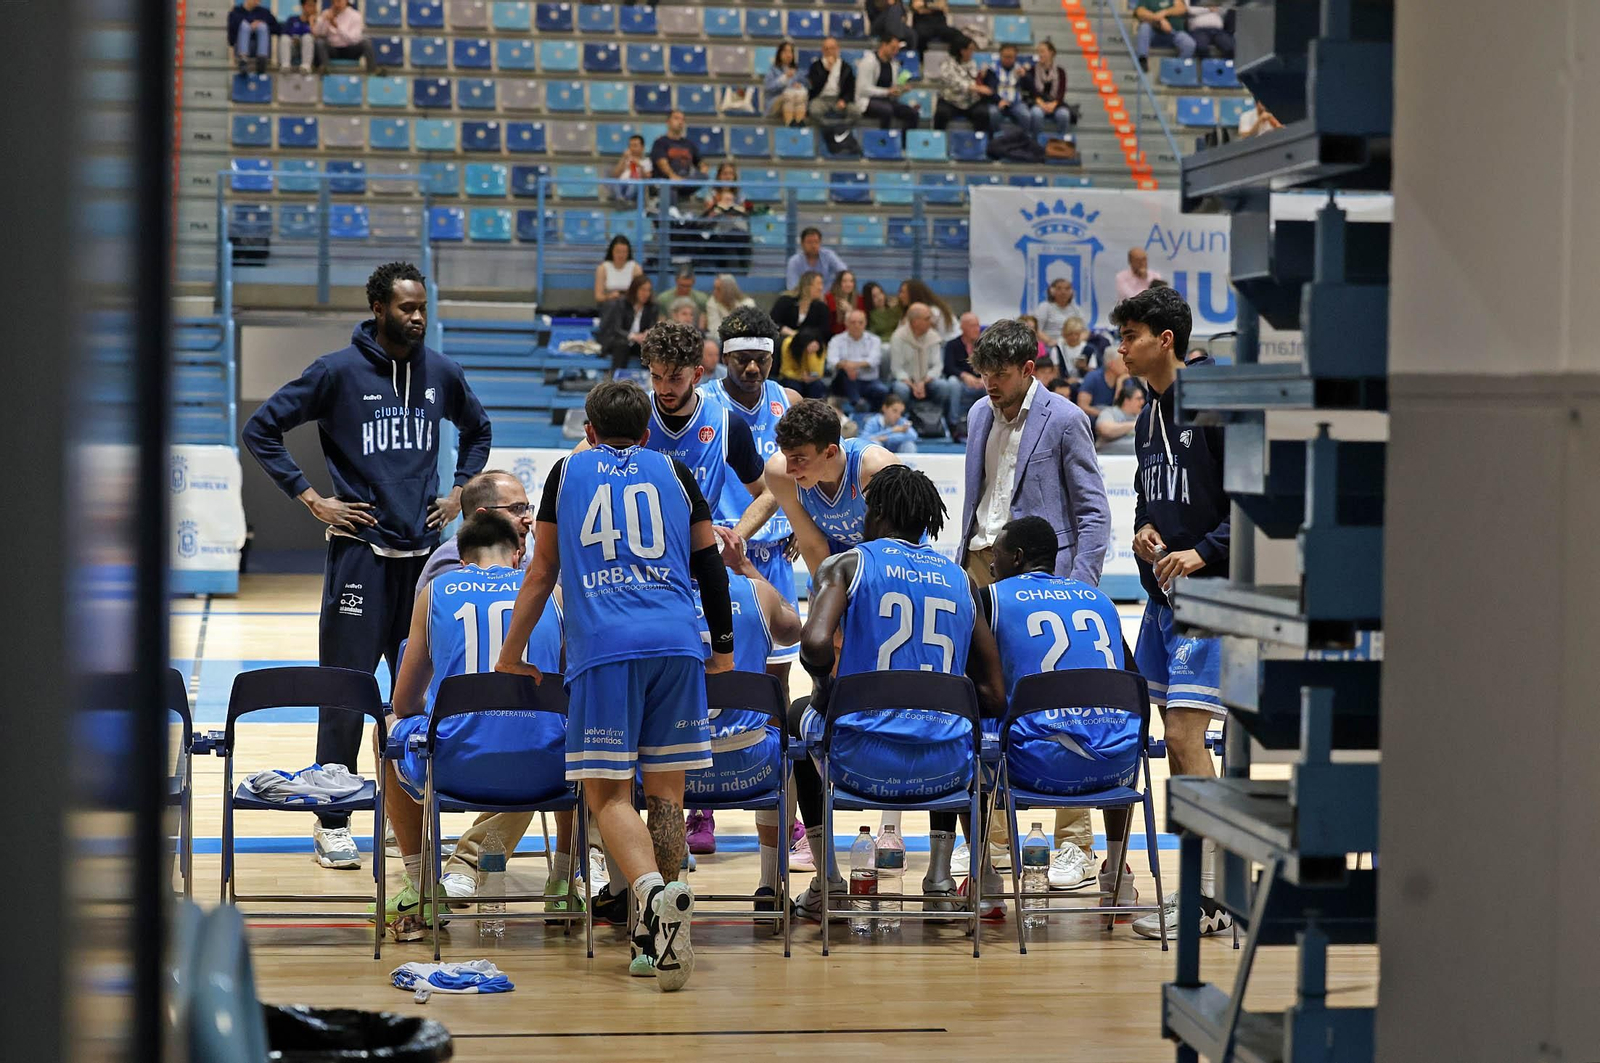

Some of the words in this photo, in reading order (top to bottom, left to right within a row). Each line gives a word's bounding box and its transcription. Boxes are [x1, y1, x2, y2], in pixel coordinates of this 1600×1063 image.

[415, 407, 425, 419] DE
[597, 461, 639, 477] MAYS
[579, 482, 666, 562] 40
[886, 564, 952, 588] MICHEL
[1015, 589, 1072, 601] CHABI
[1072, 589, 1097, 601] YO
[876, 591, 957, 674] 25
[1026, 609, 1118, 672] 23
